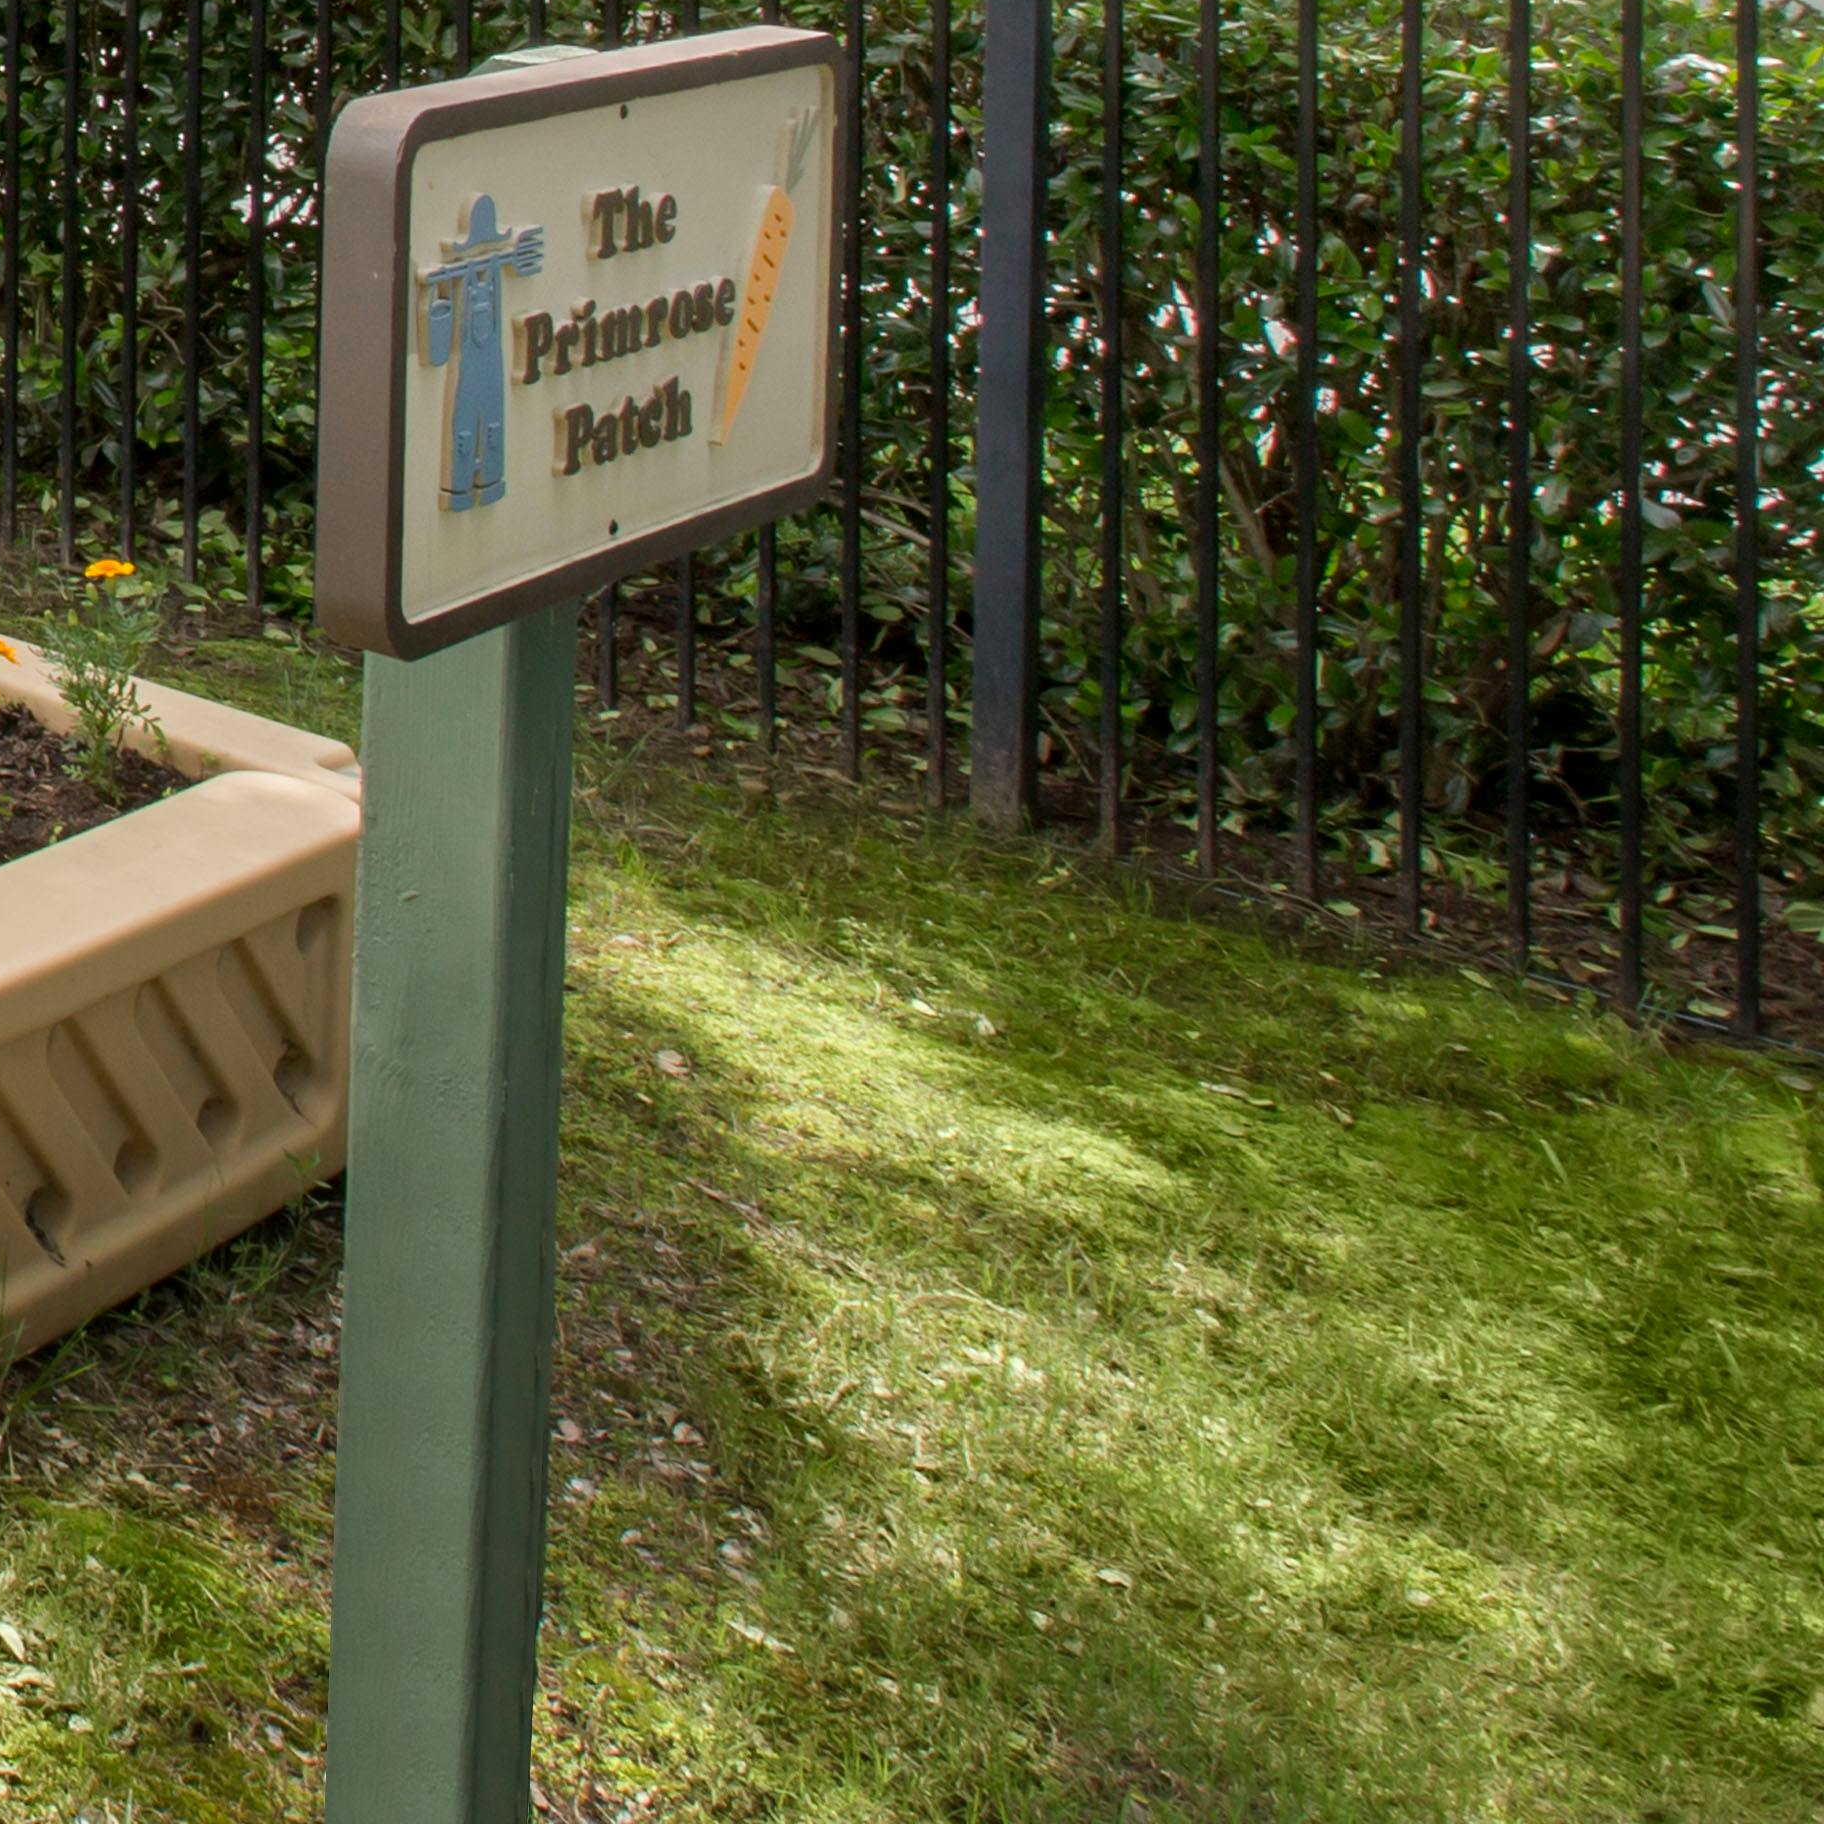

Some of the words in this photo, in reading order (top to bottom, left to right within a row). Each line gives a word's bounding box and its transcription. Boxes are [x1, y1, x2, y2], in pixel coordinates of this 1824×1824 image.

[591, 183, 677, 259] The
[521, 276, 737, 385] Primrose
[562, 375, 694, 476] Patch
